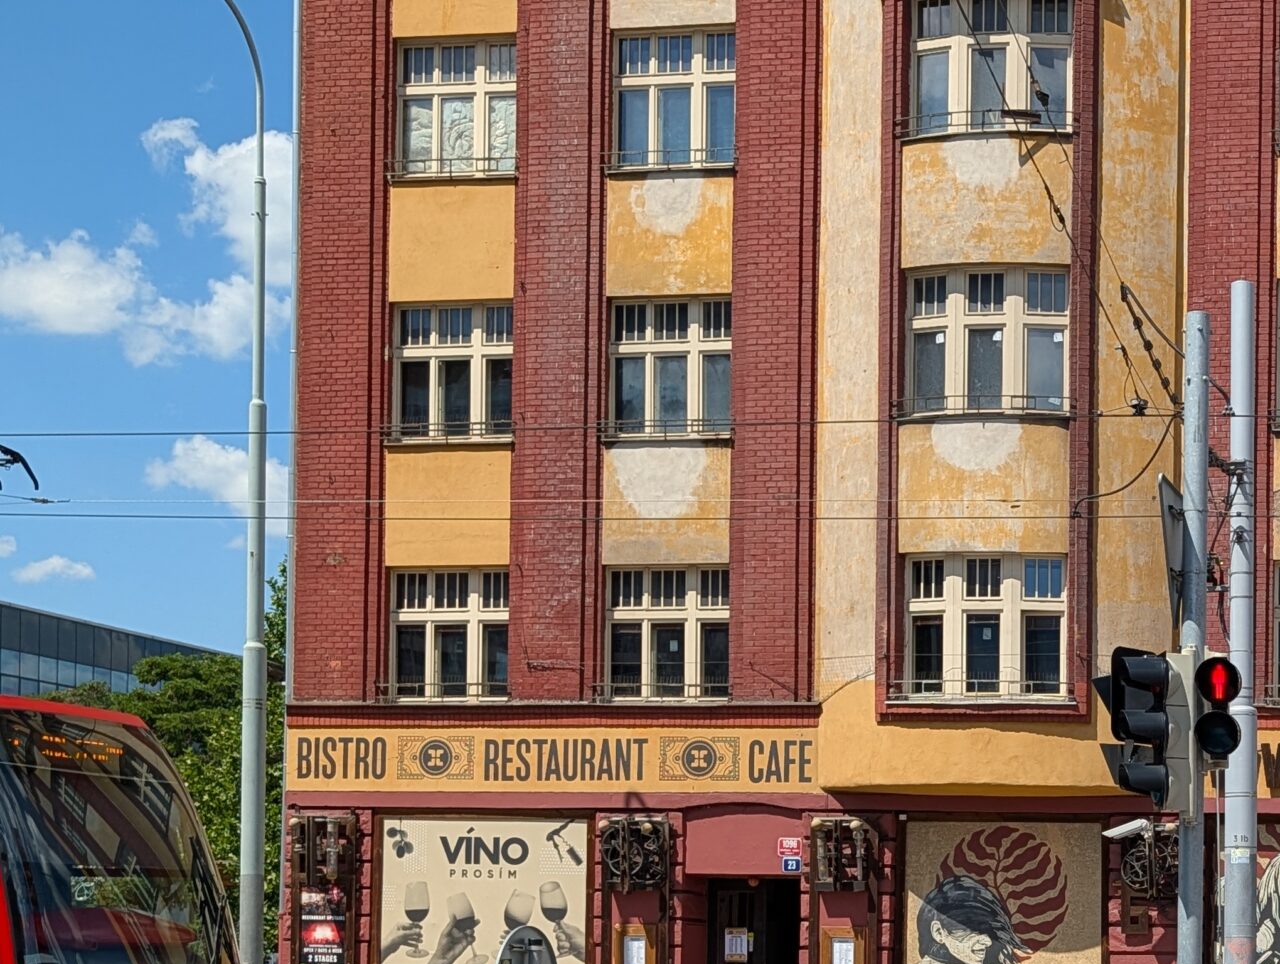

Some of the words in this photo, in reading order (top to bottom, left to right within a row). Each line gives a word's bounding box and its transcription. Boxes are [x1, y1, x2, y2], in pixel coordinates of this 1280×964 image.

[297, 736, 387, 780] BISTRO
[484, 738, 648, 782] RESTAURANT
[748, 739, 813, 784] CAFE
[439, 826, 529, 865] VÍNO
[787, 860, 796, 870] 23
[449, 867, 517, 879] PROSÍM
[308, 954, 313, 962] 2
[314, 954, 338, 963] STAGES
